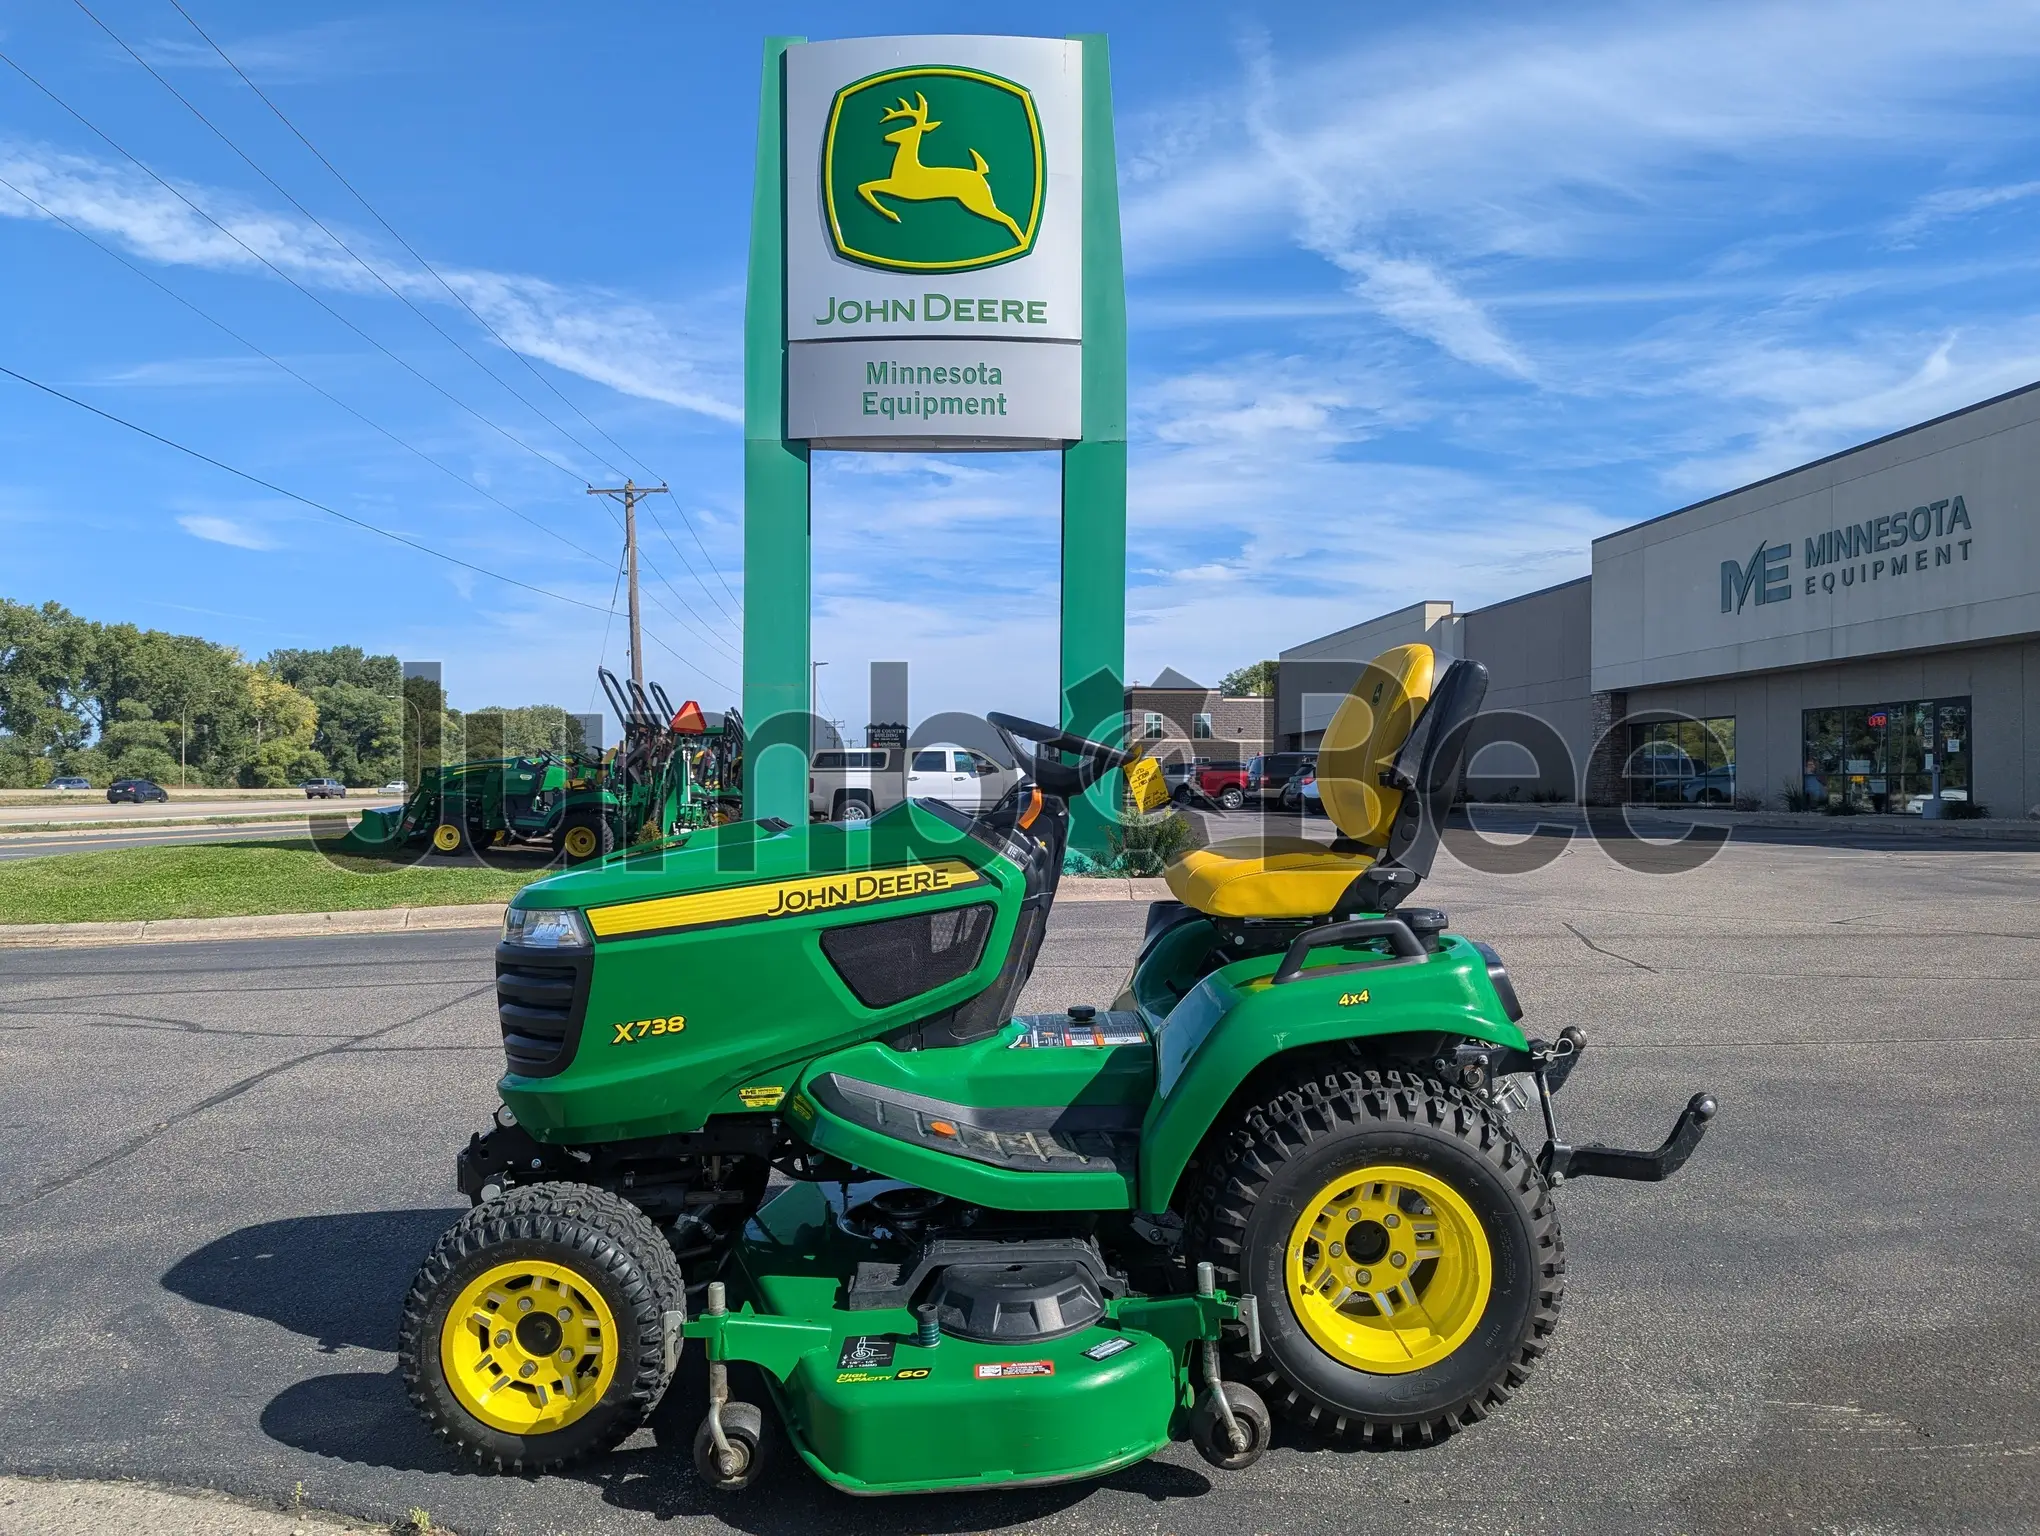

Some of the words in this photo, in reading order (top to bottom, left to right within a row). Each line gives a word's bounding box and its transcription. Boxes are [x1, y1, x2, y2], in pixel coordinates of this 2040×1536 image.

[815, 297, 916, 325] JOHN
[923, 293, 1048, 324] DEERE
[866, 361, 1003, 386] Minnesota
[862, 391, 1008, 420] Equipment
[1804, 495, 1972, 569] MINNESOTA
[1804, 539, 1973, 595] EQUIPMENT
[767, 883, 847, 914] JOHN
[855, 868, 949, 898] DEERE
[1338, 989, 1369, 1006] 4x4
[611, 1014, 687, 1046] X738
[897, 1369, 929, 1378] 60
